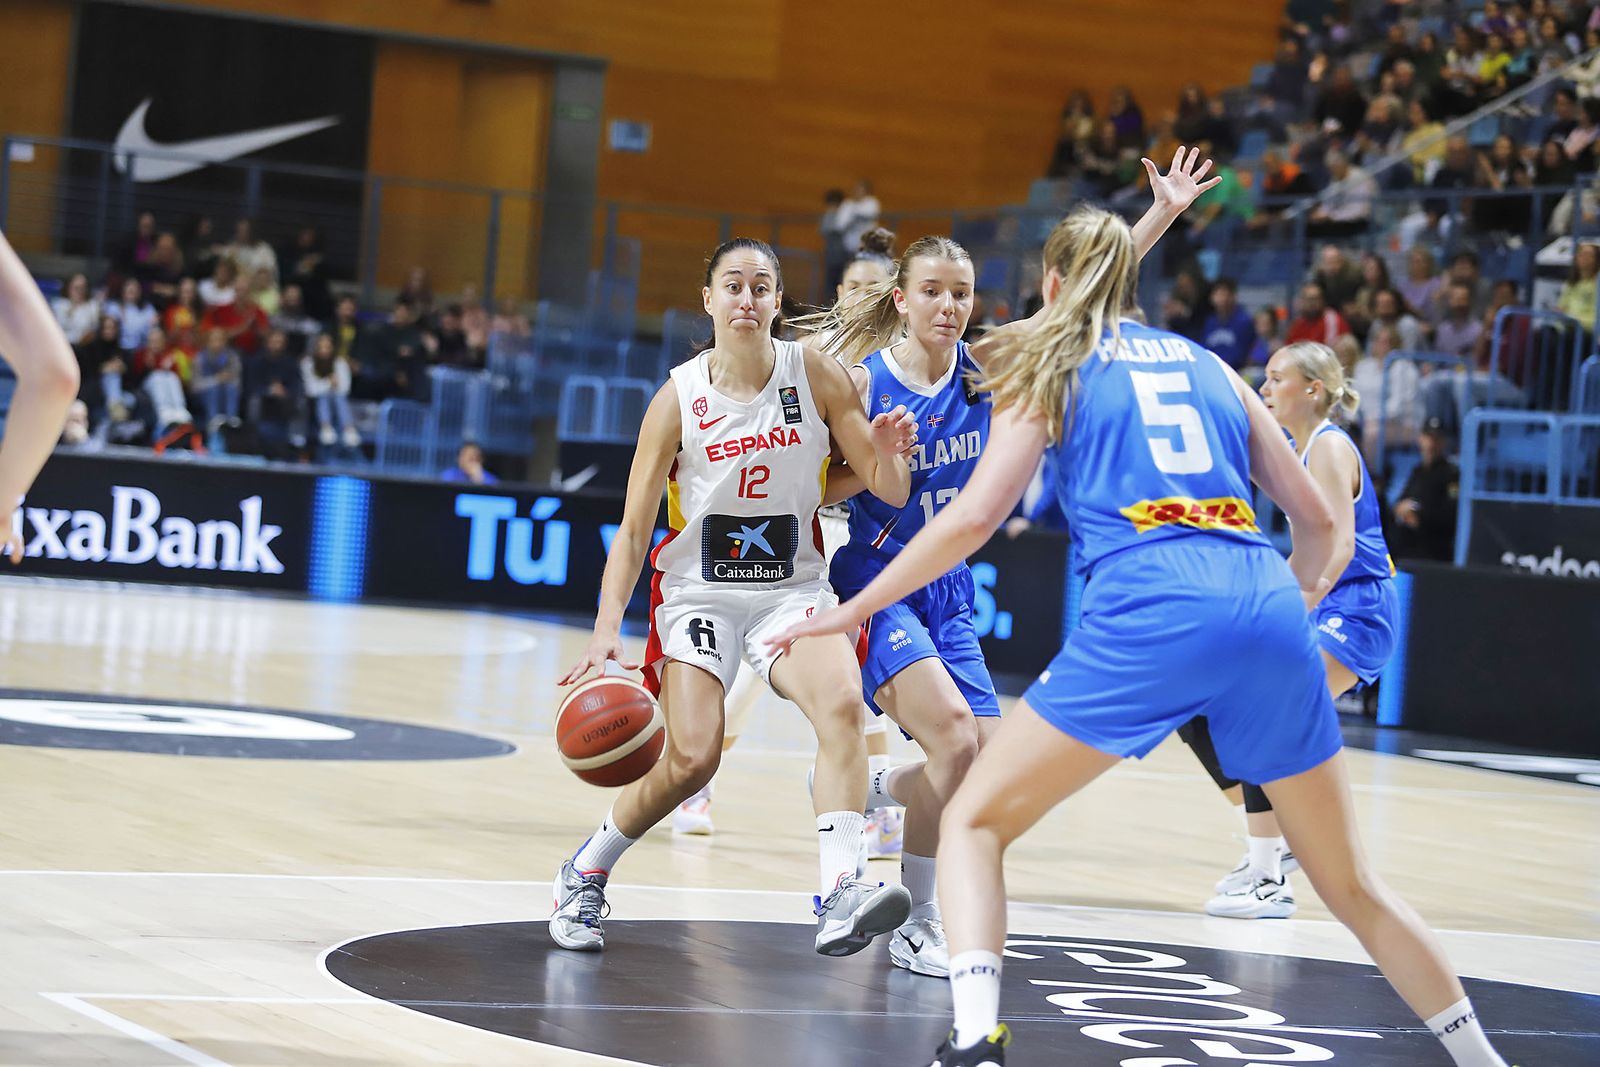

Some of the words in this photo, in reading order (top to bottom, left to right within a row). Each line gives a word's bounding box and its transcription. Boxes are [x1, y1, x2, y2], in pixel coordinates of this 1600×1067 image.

[1129, 370, 1213, 475] 5
[705, 427, 802, 463] ESPAÑA
[737, 464, 770, 499] 12
[3, 485, 285, 575] ixaBank
[455, 493, 571, 586] Tú
[714, 563, 785, 579] CaixaBank
[582, 715, 629, 743] molten
